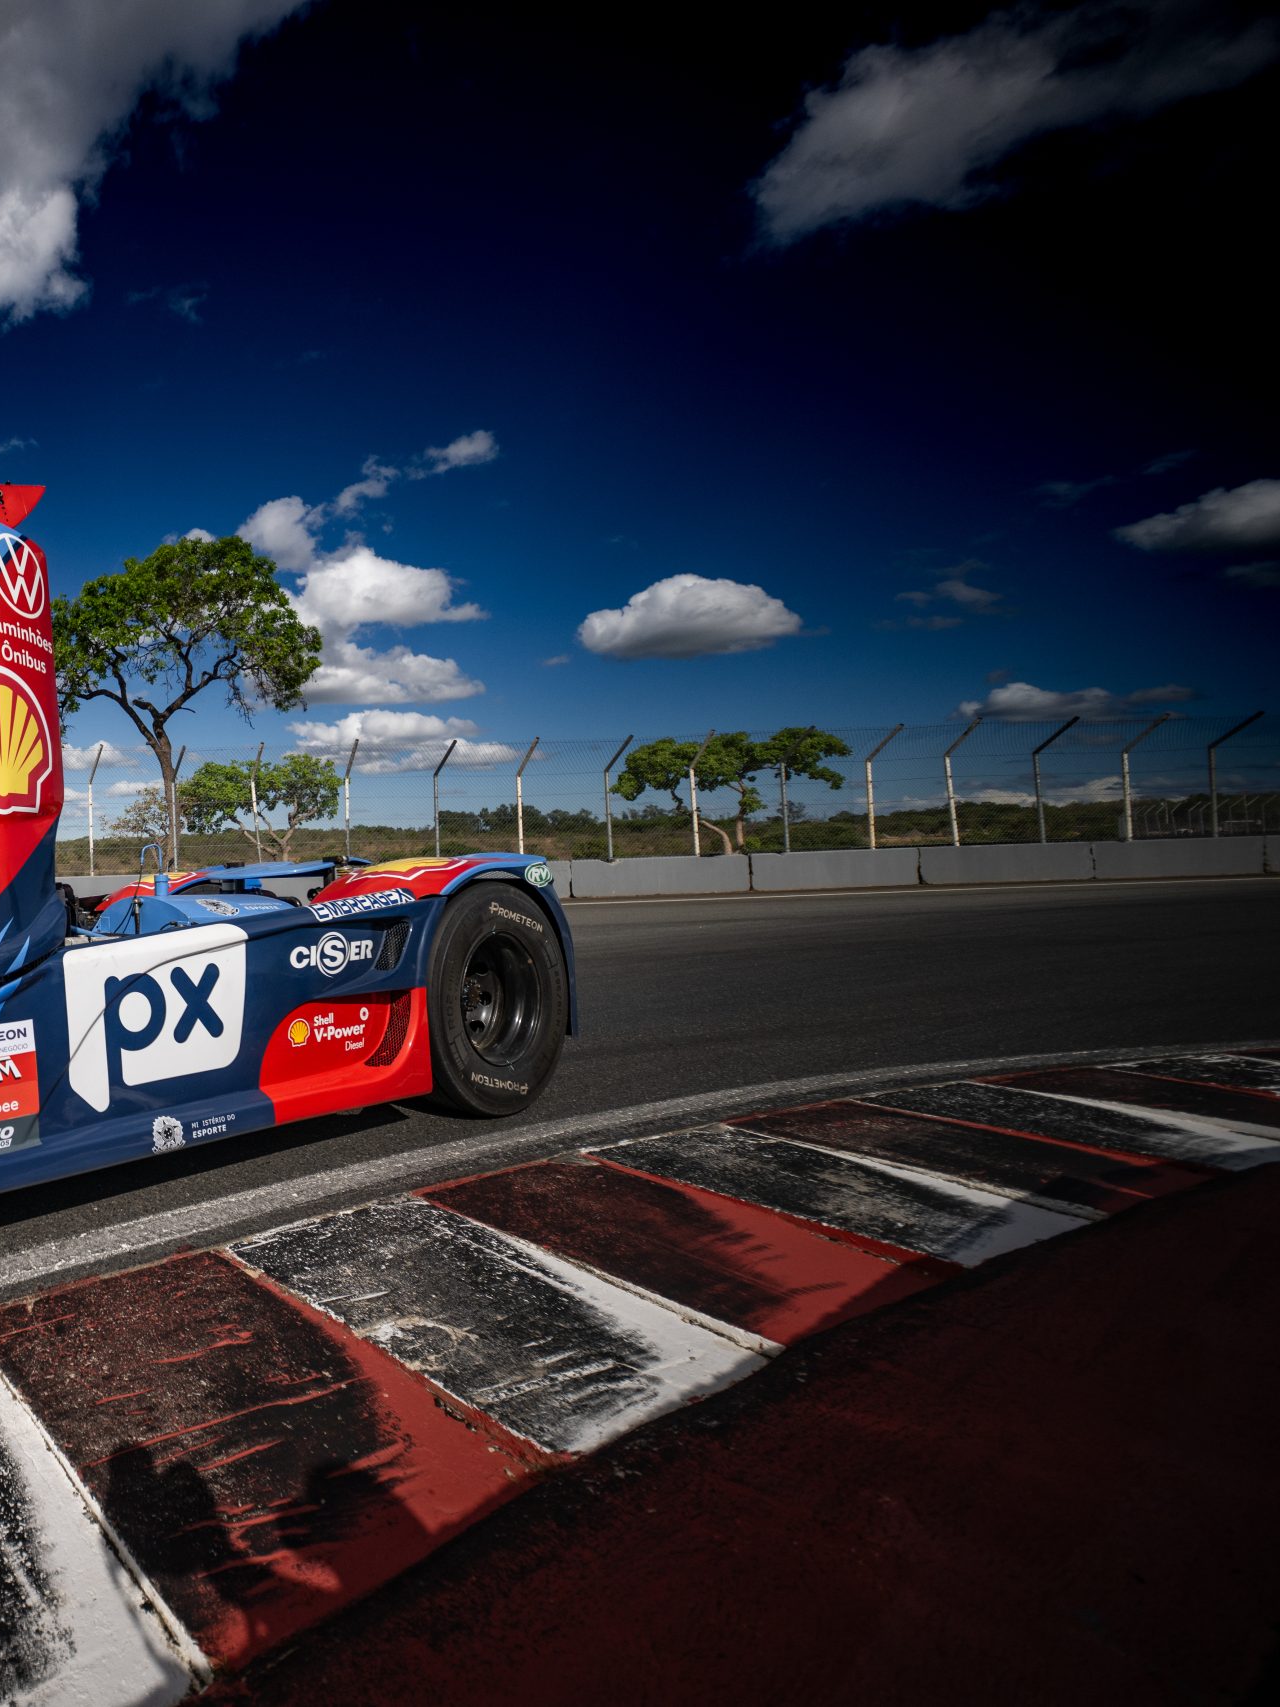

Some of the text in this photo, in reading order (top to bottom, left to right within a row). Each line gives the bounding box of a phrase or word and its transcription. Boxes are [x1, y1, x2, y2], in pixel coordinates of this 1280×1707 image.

[1, 640, 47, 674] Ônibus
[312, 888, 414, 921] EMBREAGEX
[488, 901, 543, 934] PROMETEON
[289, 936, 374, 973] CISER
[104, 963, 225, 1088] px
[313, 1012, 334, 1027] Shell
[313, 1024, 366, 1043] V-Power
[345, 1037, 365, 1051] Diesel
[470, 1071, 529, 1096] PROMETEON
[191, 1115, 226, 1129] MIISTÉRIO
[192, 1124, 227, 1139] ESPORTE
